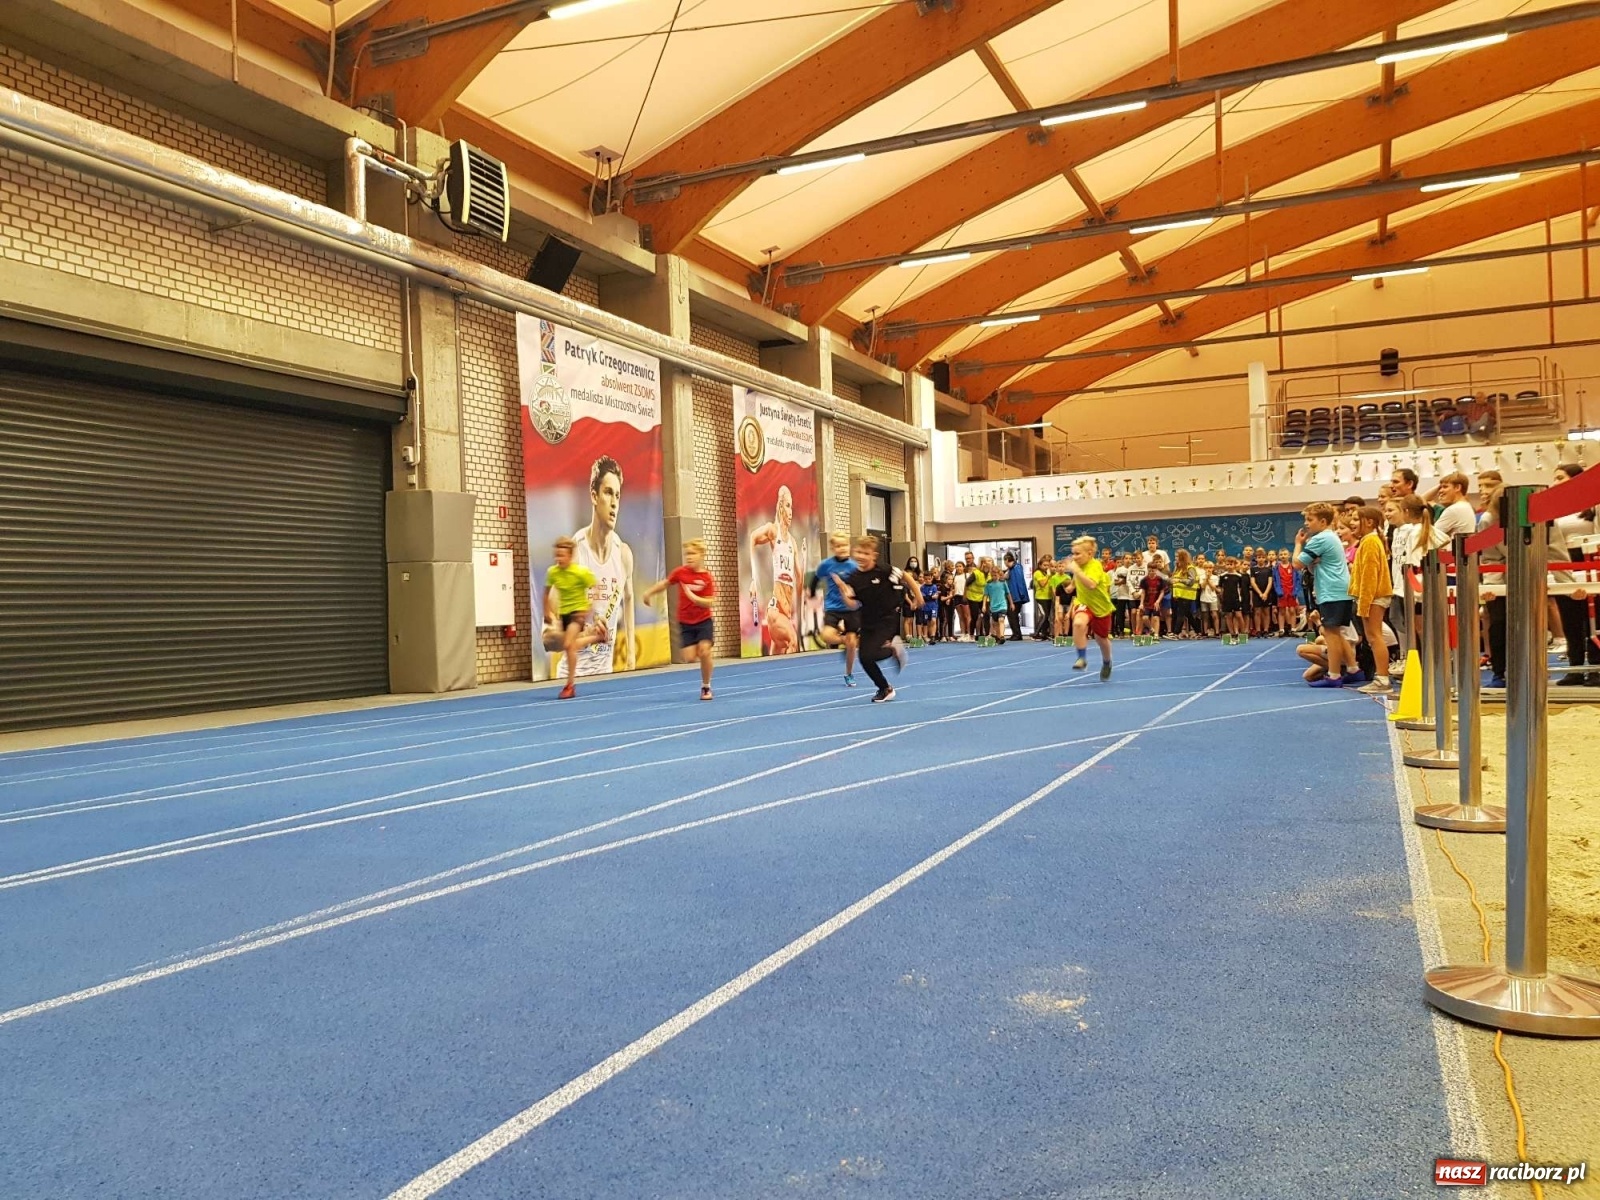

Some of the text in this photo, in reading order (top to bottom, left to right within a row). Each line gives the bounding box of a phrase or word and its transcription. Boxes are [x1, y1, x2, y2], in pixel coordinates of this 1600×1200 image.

[565, 340, 655, 381] Patryk Grzegorzewicz
[601, 374, 655, 401] absolwent ZSOMS
[570, 388, 604, 405] medalista
[605, 395, 637, 415] Mistrzostw
[760, 403, 780, 420] Justyna
[780, 555, 791, 572] POL
